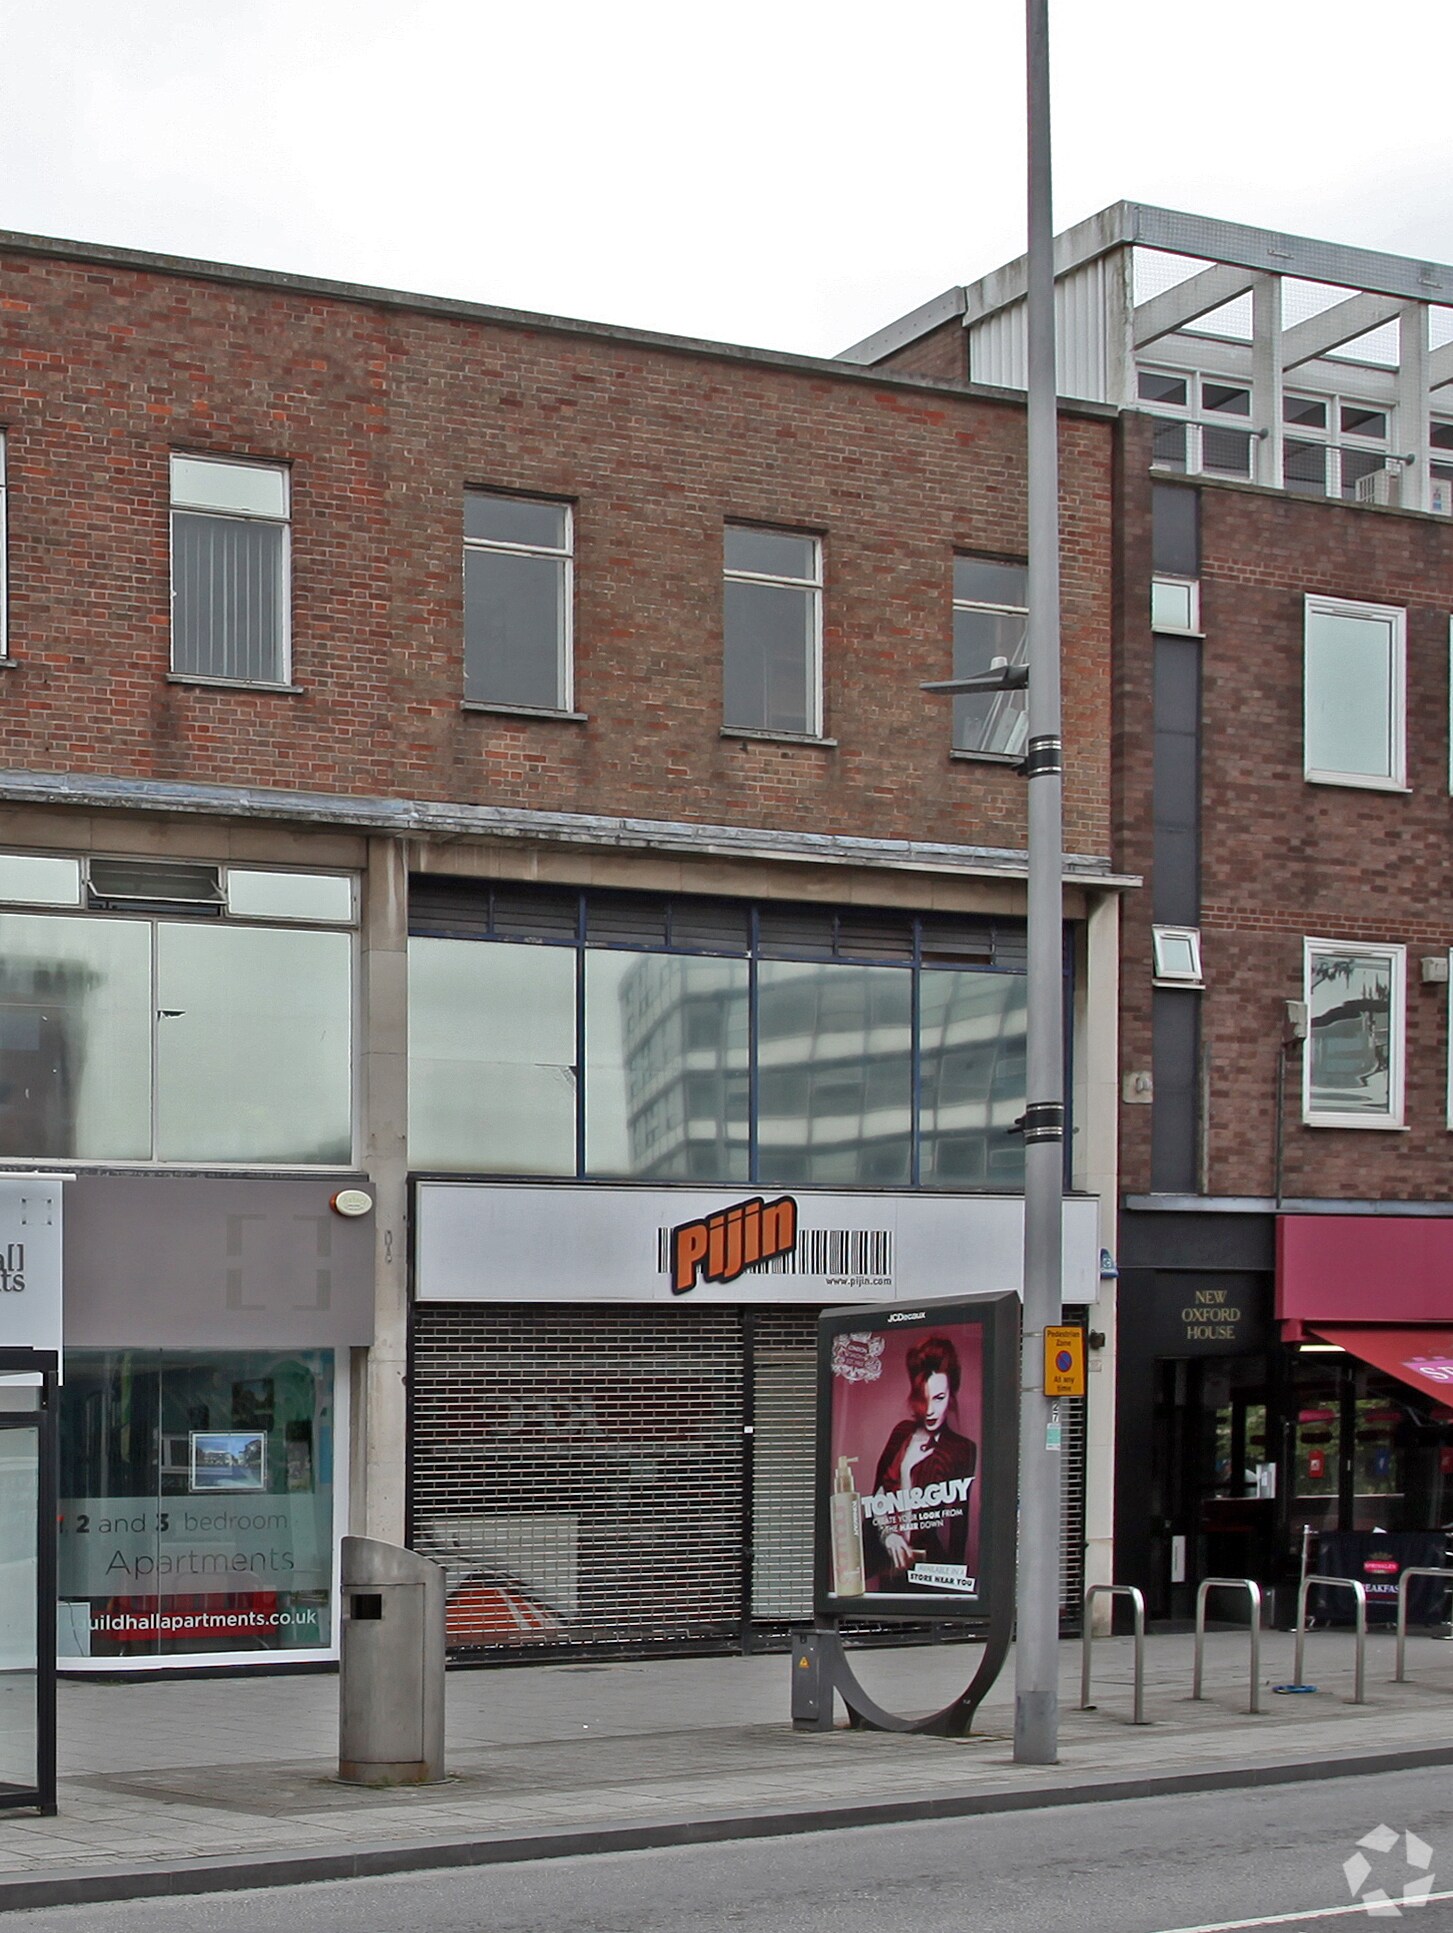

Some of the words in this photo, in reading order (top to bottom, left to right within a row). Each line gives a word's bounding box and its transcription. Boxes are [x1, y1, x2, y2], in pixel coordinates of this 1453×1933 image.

[826, 1276, 892, 1287] www.pijin.com
[1195, 1290, 1227, 1304] NEW
[888, 1312, 925, 1323] JCDecaux
[1182, 1308, 1241, 1322] OXFORD
[1047, 1330, 1080, 1338] Pedestrian
[1187, 1326, 1236, 1339] HOUSE
[1056, 1339, 1071, 1347] Zone
[861, 1477, 976, 1518] TONI&GUY
[919, 1511, 940, 1520] LOOK
[941, 1509, 963, 1518] FROM
[76, 1514, 90, 1534] 2
[98, 1512, 146, 1534] and
[156, 1512, 170, 1532] 3
[184, 1511, 288, 1532] bedroom
[920, 1519, 944, 1529] DOWN
[105, 1547, 295, 1580] Apartments
[911, 1573, 932, 1582] STORE
[935, 1576, 955, 1585] NEAR
[957, 1579, 973, 1587] YOU
[88, 1609, 317, 1631] uildhallapartments.co.uk
